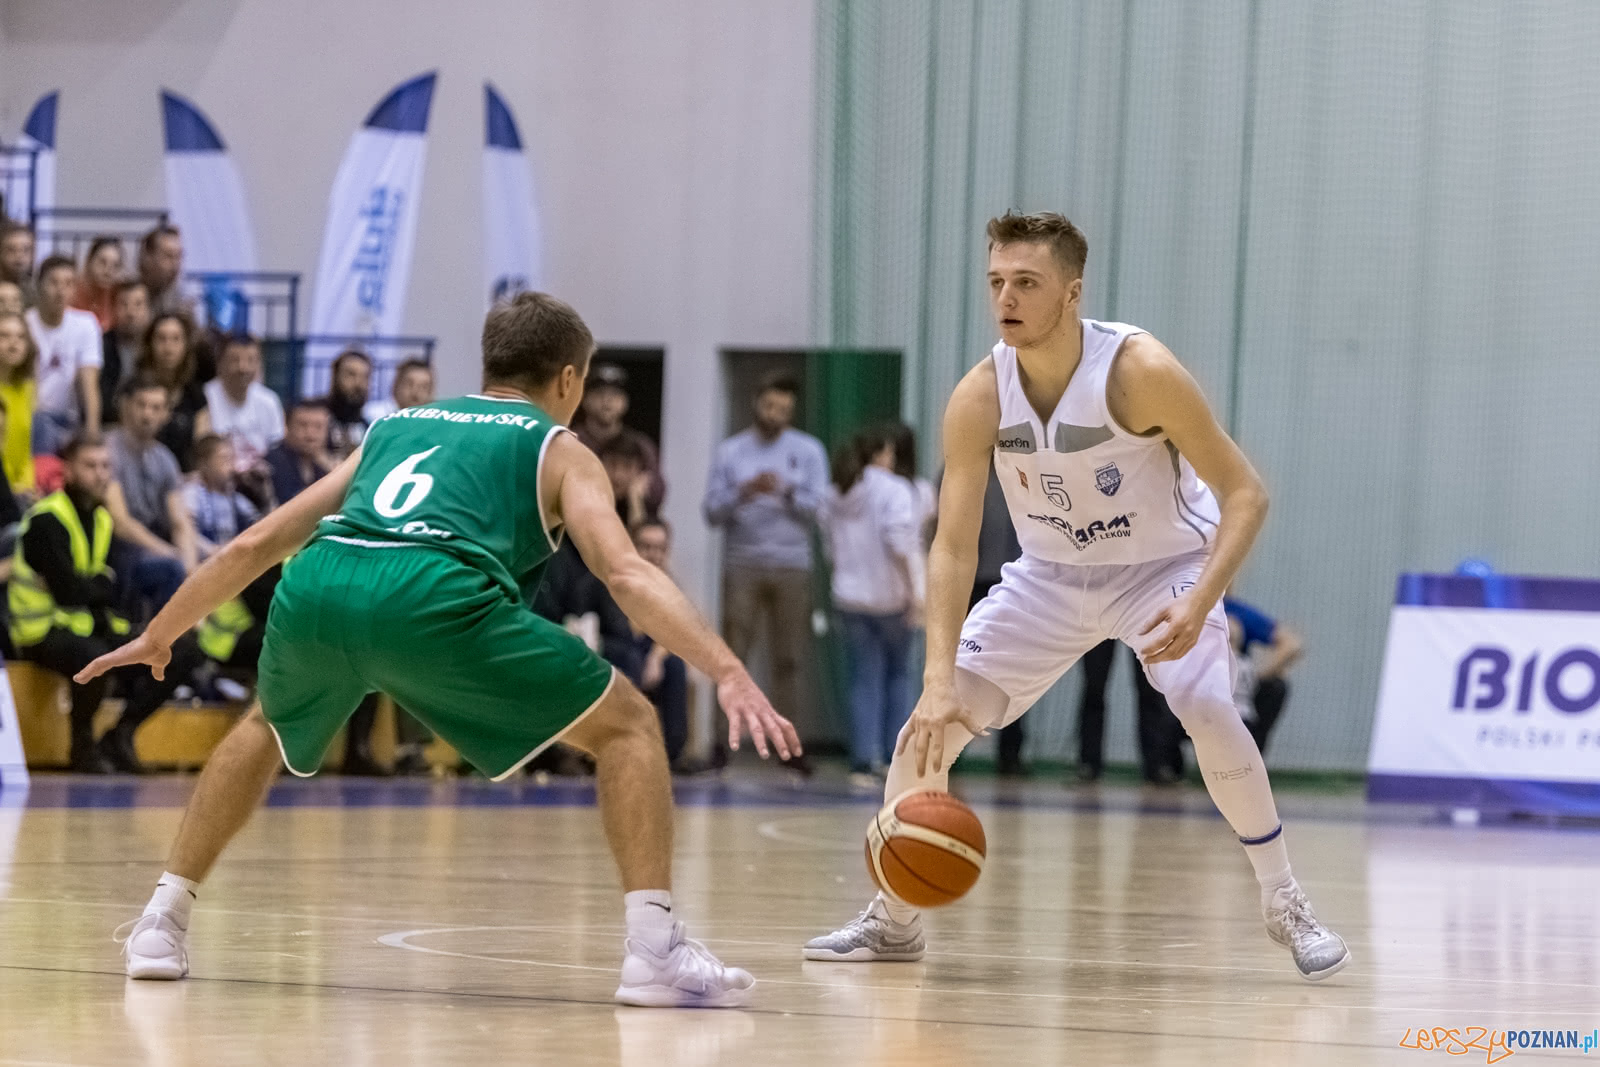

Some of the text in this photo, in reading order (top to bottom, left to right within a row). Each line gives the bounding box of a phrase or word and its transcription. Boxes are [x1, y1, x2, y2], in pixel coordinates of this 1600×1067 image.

[373, 445, 442, 518] 6
[1040, 473, 1072, 511] 5
[1099, 529, 1131, 541] LEKÓW
